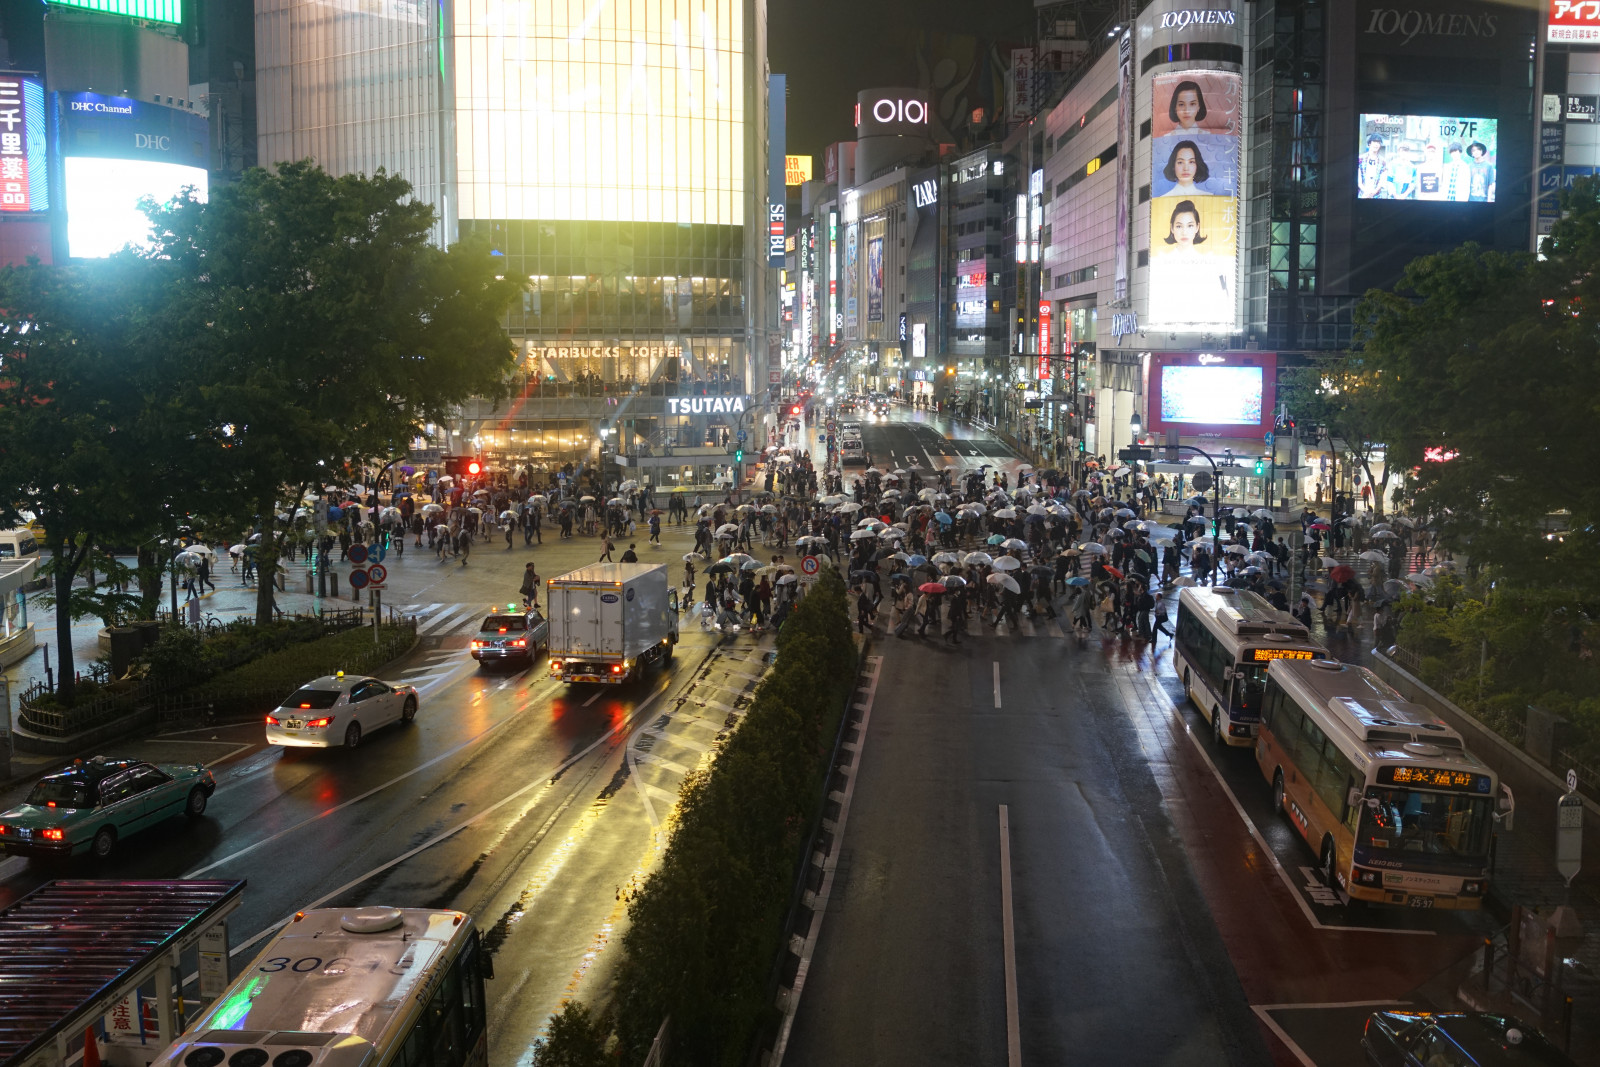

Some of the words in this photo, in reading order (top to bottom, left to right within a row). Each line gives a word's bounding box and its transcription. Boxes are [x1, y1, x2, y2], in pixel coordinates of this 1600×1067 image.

[1554, 0, 1600, 20] アイフ
[1552, 29, 1599, 39] 新規会員募集中
[1016, 54, 1028, 105] 大和証券
[71, 102, 94, 111] DHC
[95, 103, 132, 114] Channel
[1439, 125, 1457, 136] 109
[1459, 121, 1478, 137] 7F
[0, 82, 24, 204] 三千里薬品
[135, 133, 170, 150] DHC
[528, 346, 619, 358] STARBUCKS
[629, 346, 682, 358] COFFEE
[668, 397, 744, 413] TSUTAYA
